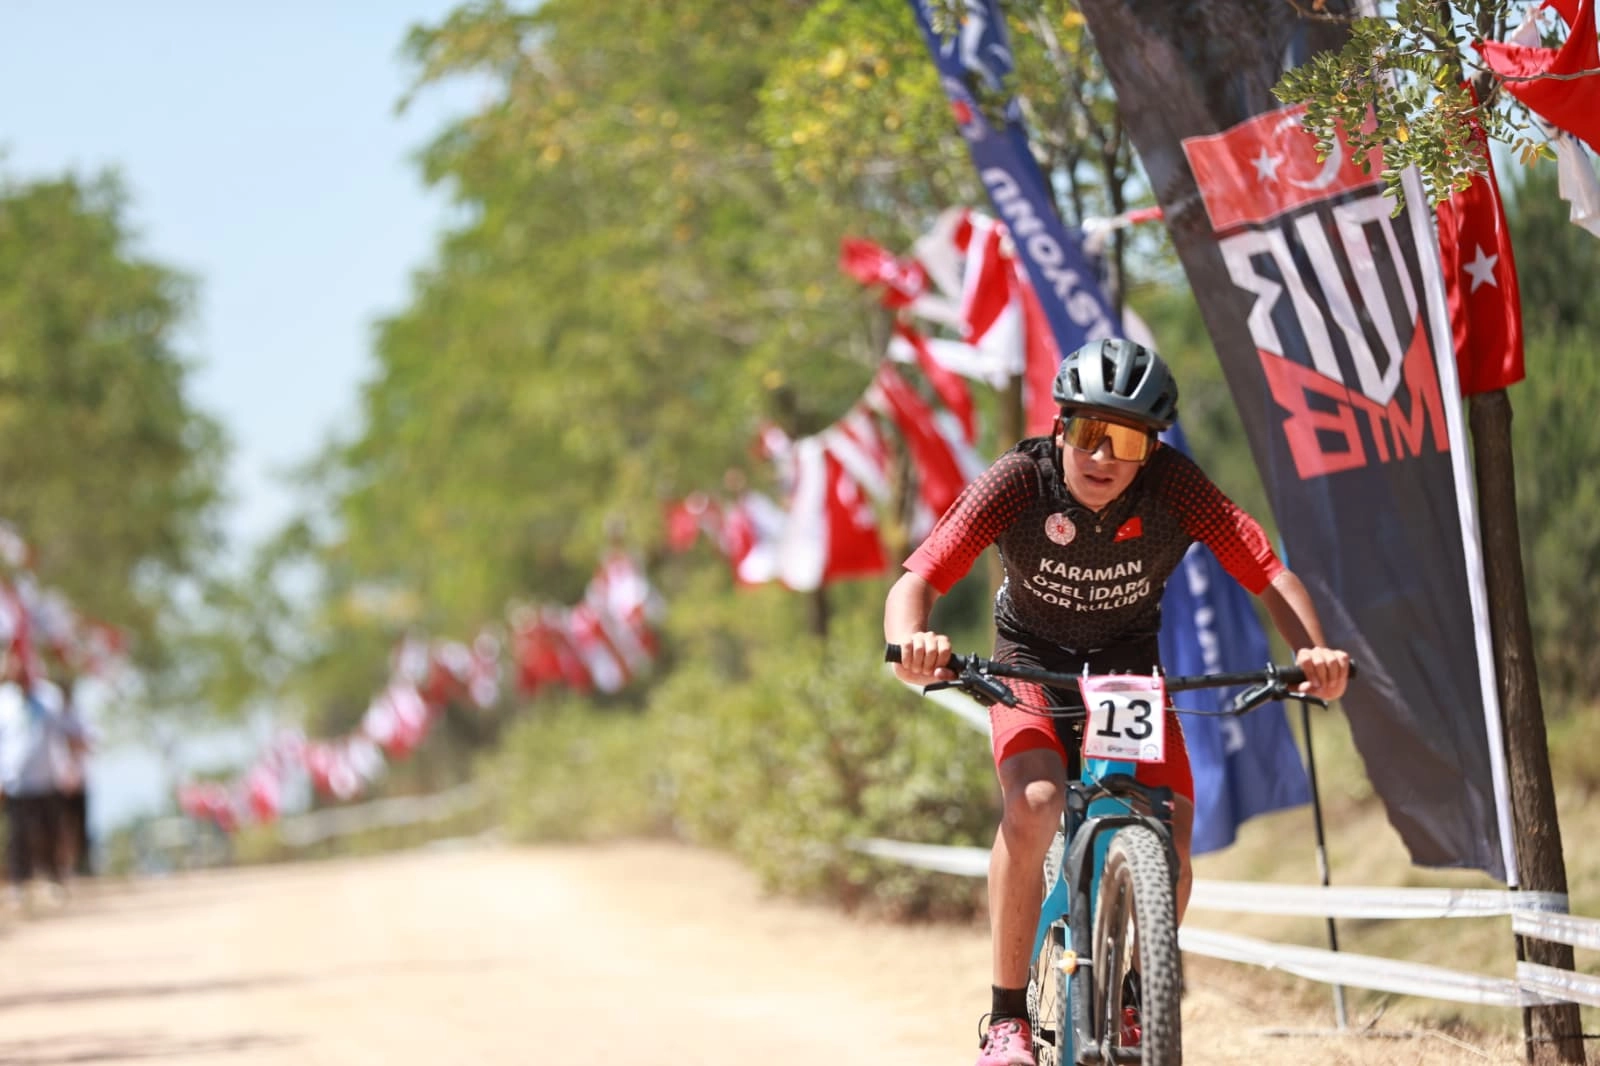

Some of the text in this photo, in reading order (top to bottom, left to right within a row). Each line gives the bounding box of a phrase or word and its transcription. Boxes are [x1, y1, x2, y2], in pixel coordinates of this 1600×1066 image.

[1039, 558, 1142, 581] KARAMAN
[1032, 574, 1085, 599] ÖZEL
[1096, 699, 1153, 740] 13
